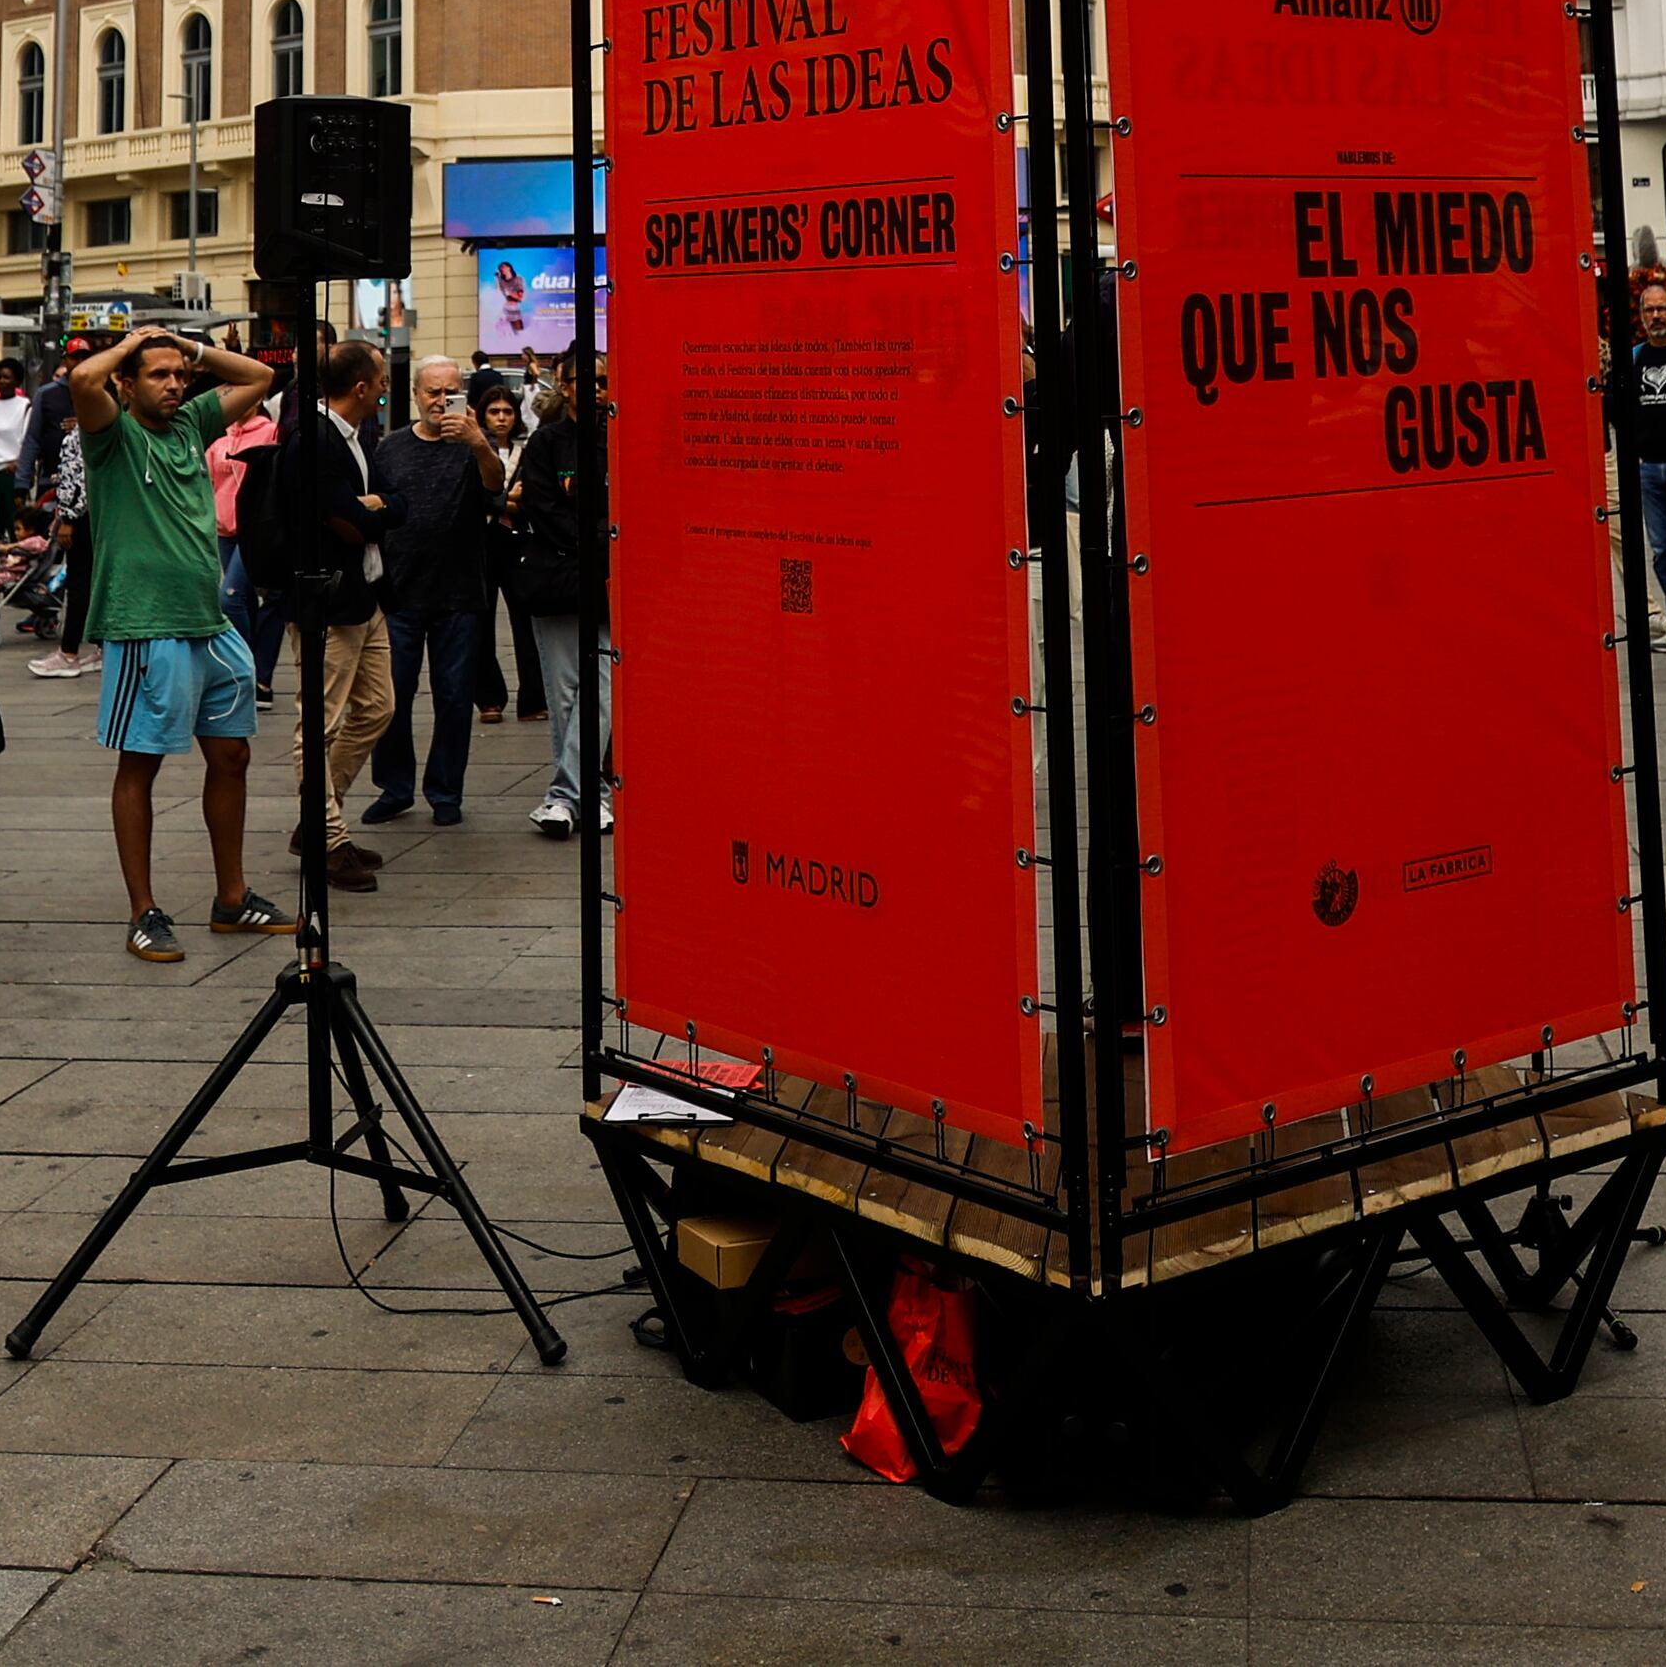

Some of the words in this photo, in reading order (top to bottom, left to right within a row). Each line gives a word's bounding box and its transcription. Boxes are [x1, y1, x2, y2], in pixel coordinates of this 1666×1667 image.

[642, 74, 700, 136] DE
[708, 59, 792, 130] LAS
[802, 37, 954, 118] IDEAS
[819, 191, 956, 261] CORNER
[1292, 190, 1358, 278] EL
[1373, 190, 1535, 277] MIEDO
[531, 272, 571, 290] dua
[1179, 291, 1296, 407] QUE
[1311, 288, 1420, 379] NOS
[1383, 378, 1548, 475] GUSTA
[765, 849, 881, 909] MADRID
[1408, 867, 1427, 884] LA
